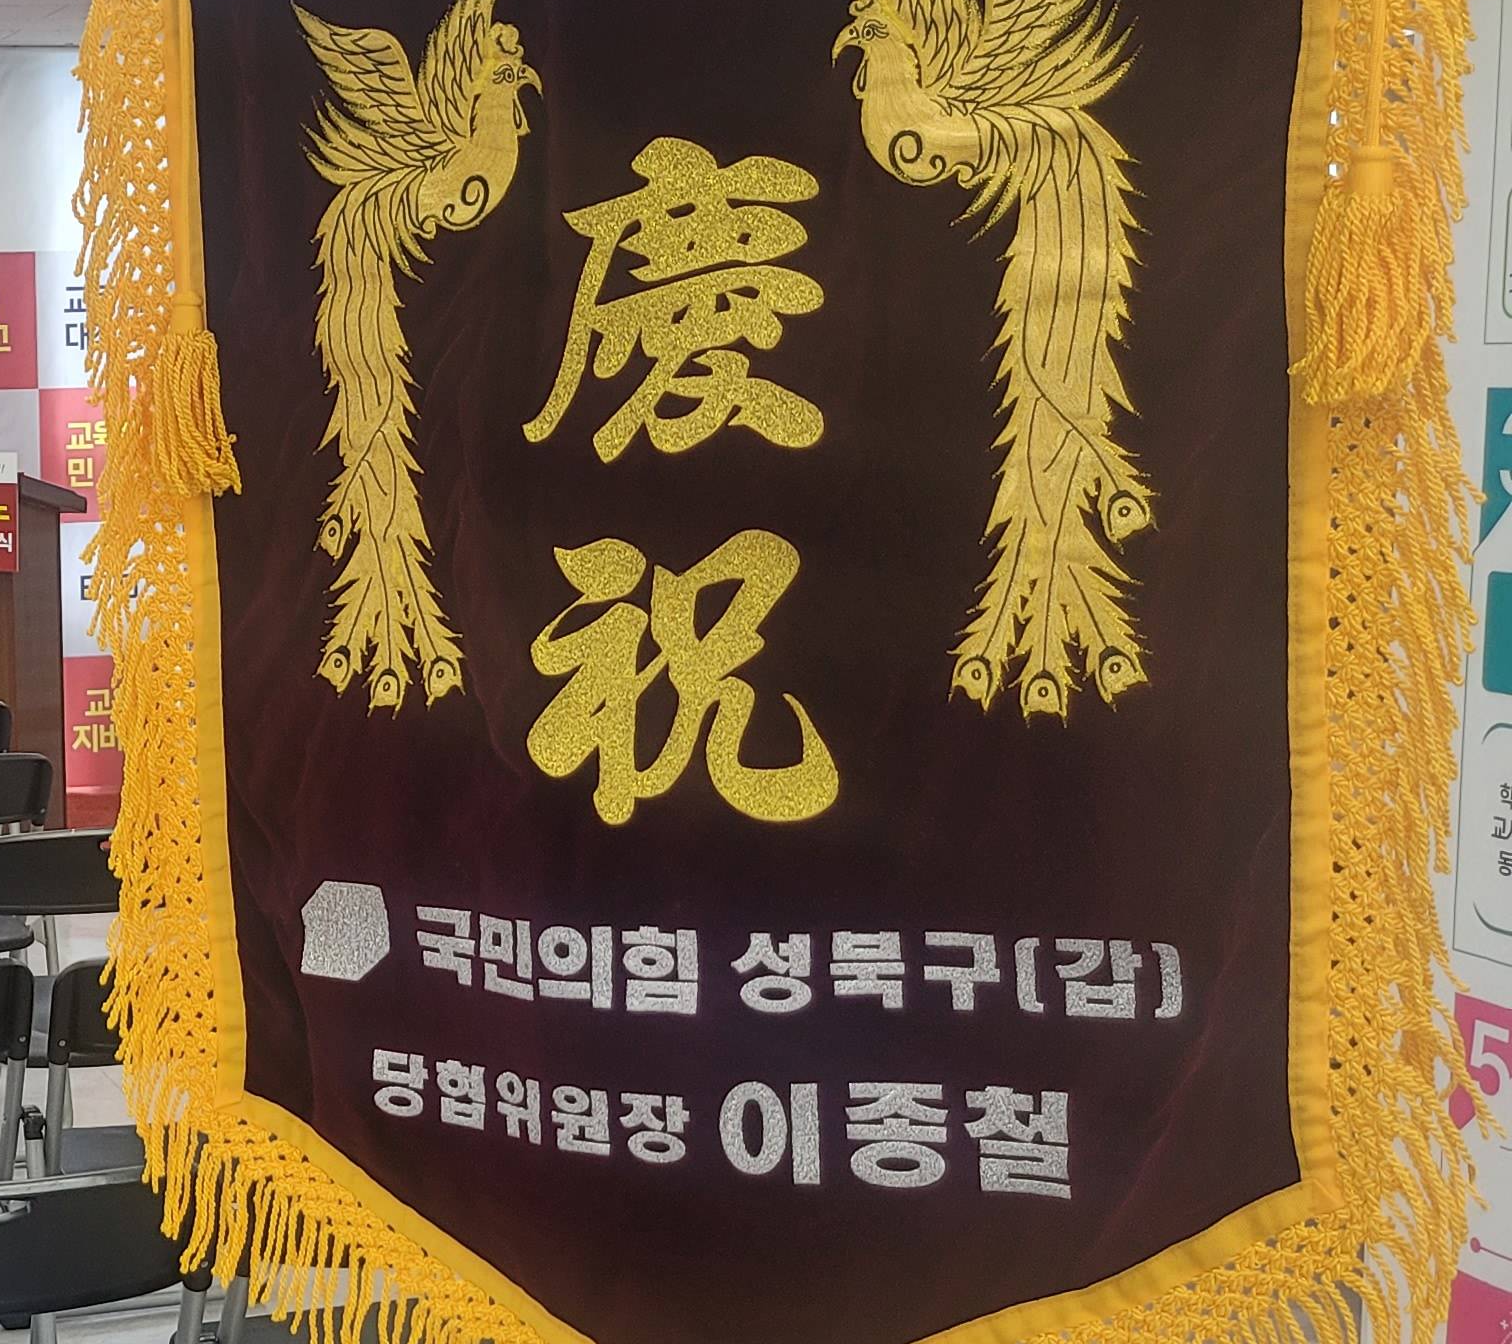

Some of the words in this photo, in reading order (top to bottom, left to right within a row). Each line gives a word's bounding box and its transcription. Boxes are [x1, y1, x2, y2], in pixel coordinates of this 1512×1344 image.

[414, 904, 699, 1016] 국민의힘
[729, 928, 1184, 1020] 성북구(갑)
[371, 1047, 690, 1165] 당협위원장
[718, 1079, 1074, 1201] 이종철
